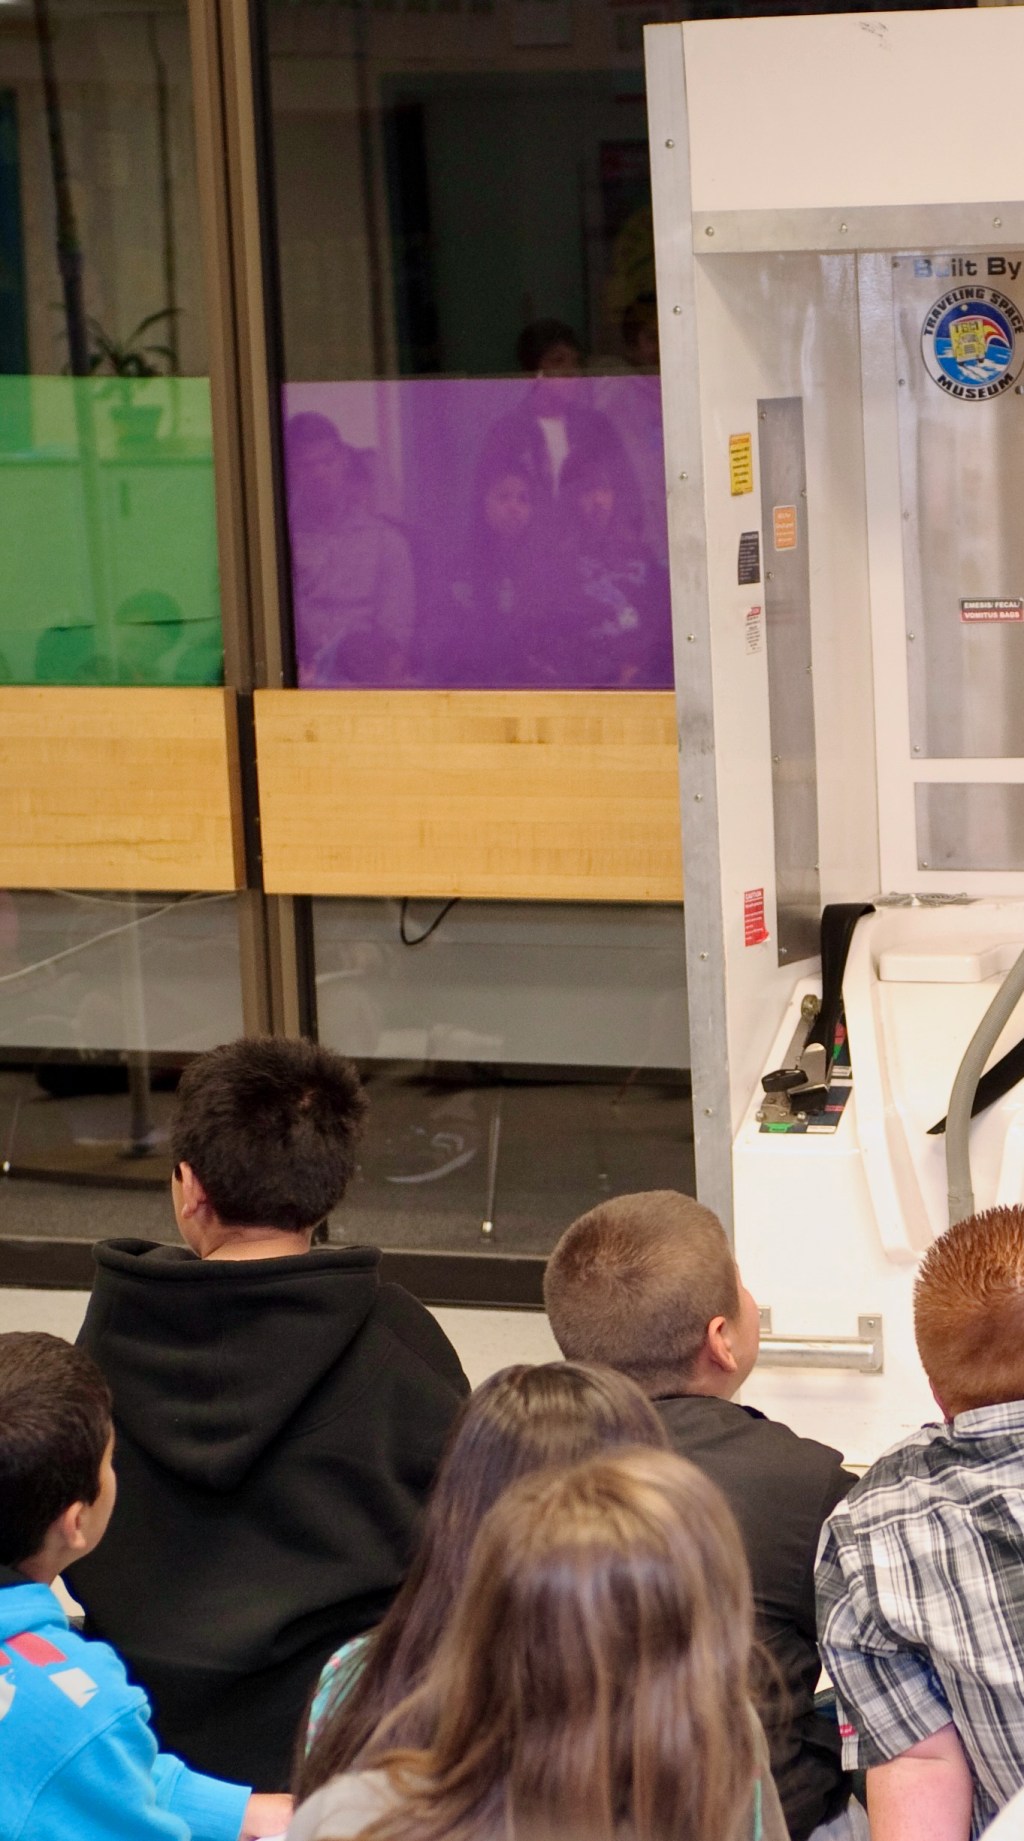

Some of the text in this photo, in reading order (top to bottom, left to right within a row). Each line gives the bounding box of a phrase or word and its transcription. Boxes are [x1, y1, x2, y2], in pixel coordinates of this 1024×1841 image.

[914, 258, 977, 278] Built
[924, 288, 1024, 336] TRAVELING SPACE
[937, 373, 1014, 399] MUSEUM
